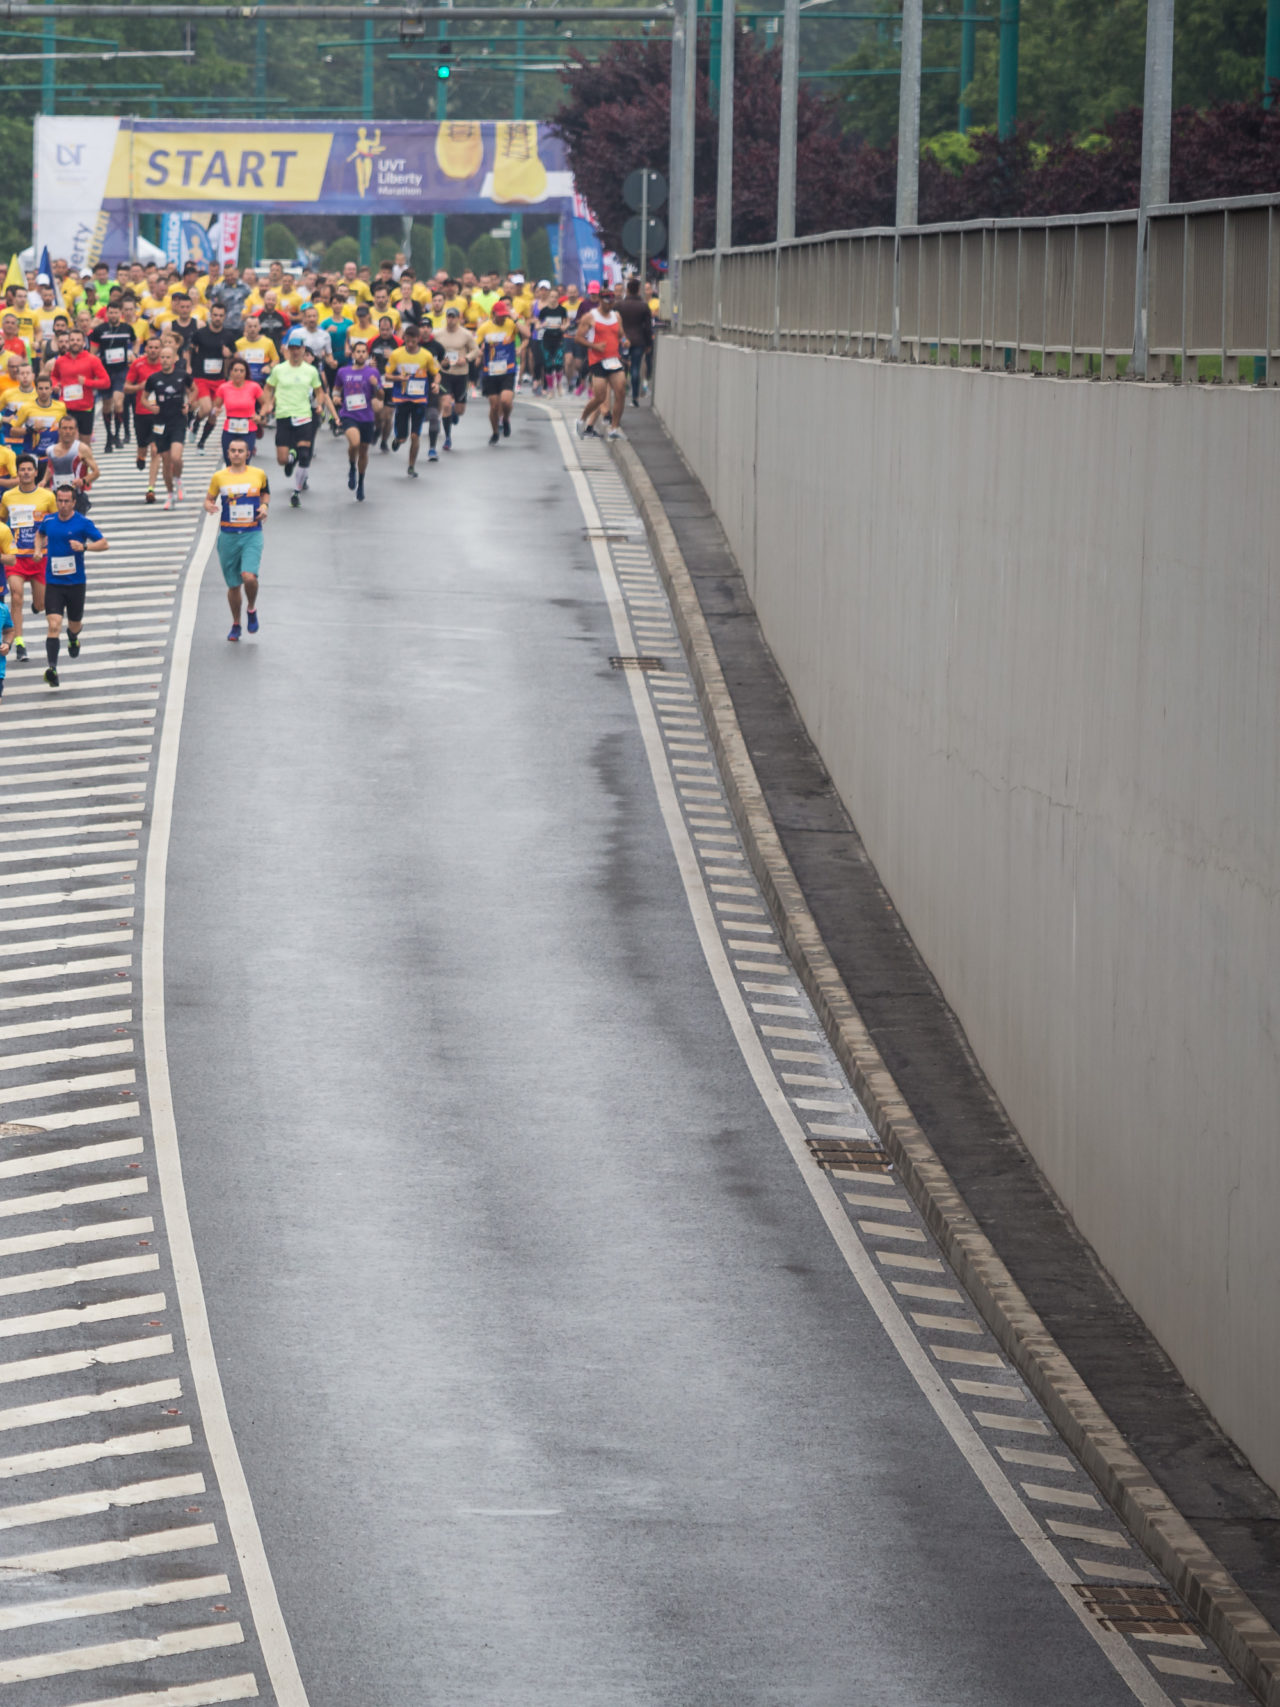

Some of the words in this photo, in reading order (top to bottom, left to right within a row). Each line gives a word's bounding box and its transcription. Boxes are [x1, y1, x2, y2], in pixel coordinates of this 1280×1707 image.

[145, 149, 298, 188] START
[378, 159, 406, 171] UVT
[378, 172, 423, 187] Liberty
[378, 186, 422, 196] Marathon
